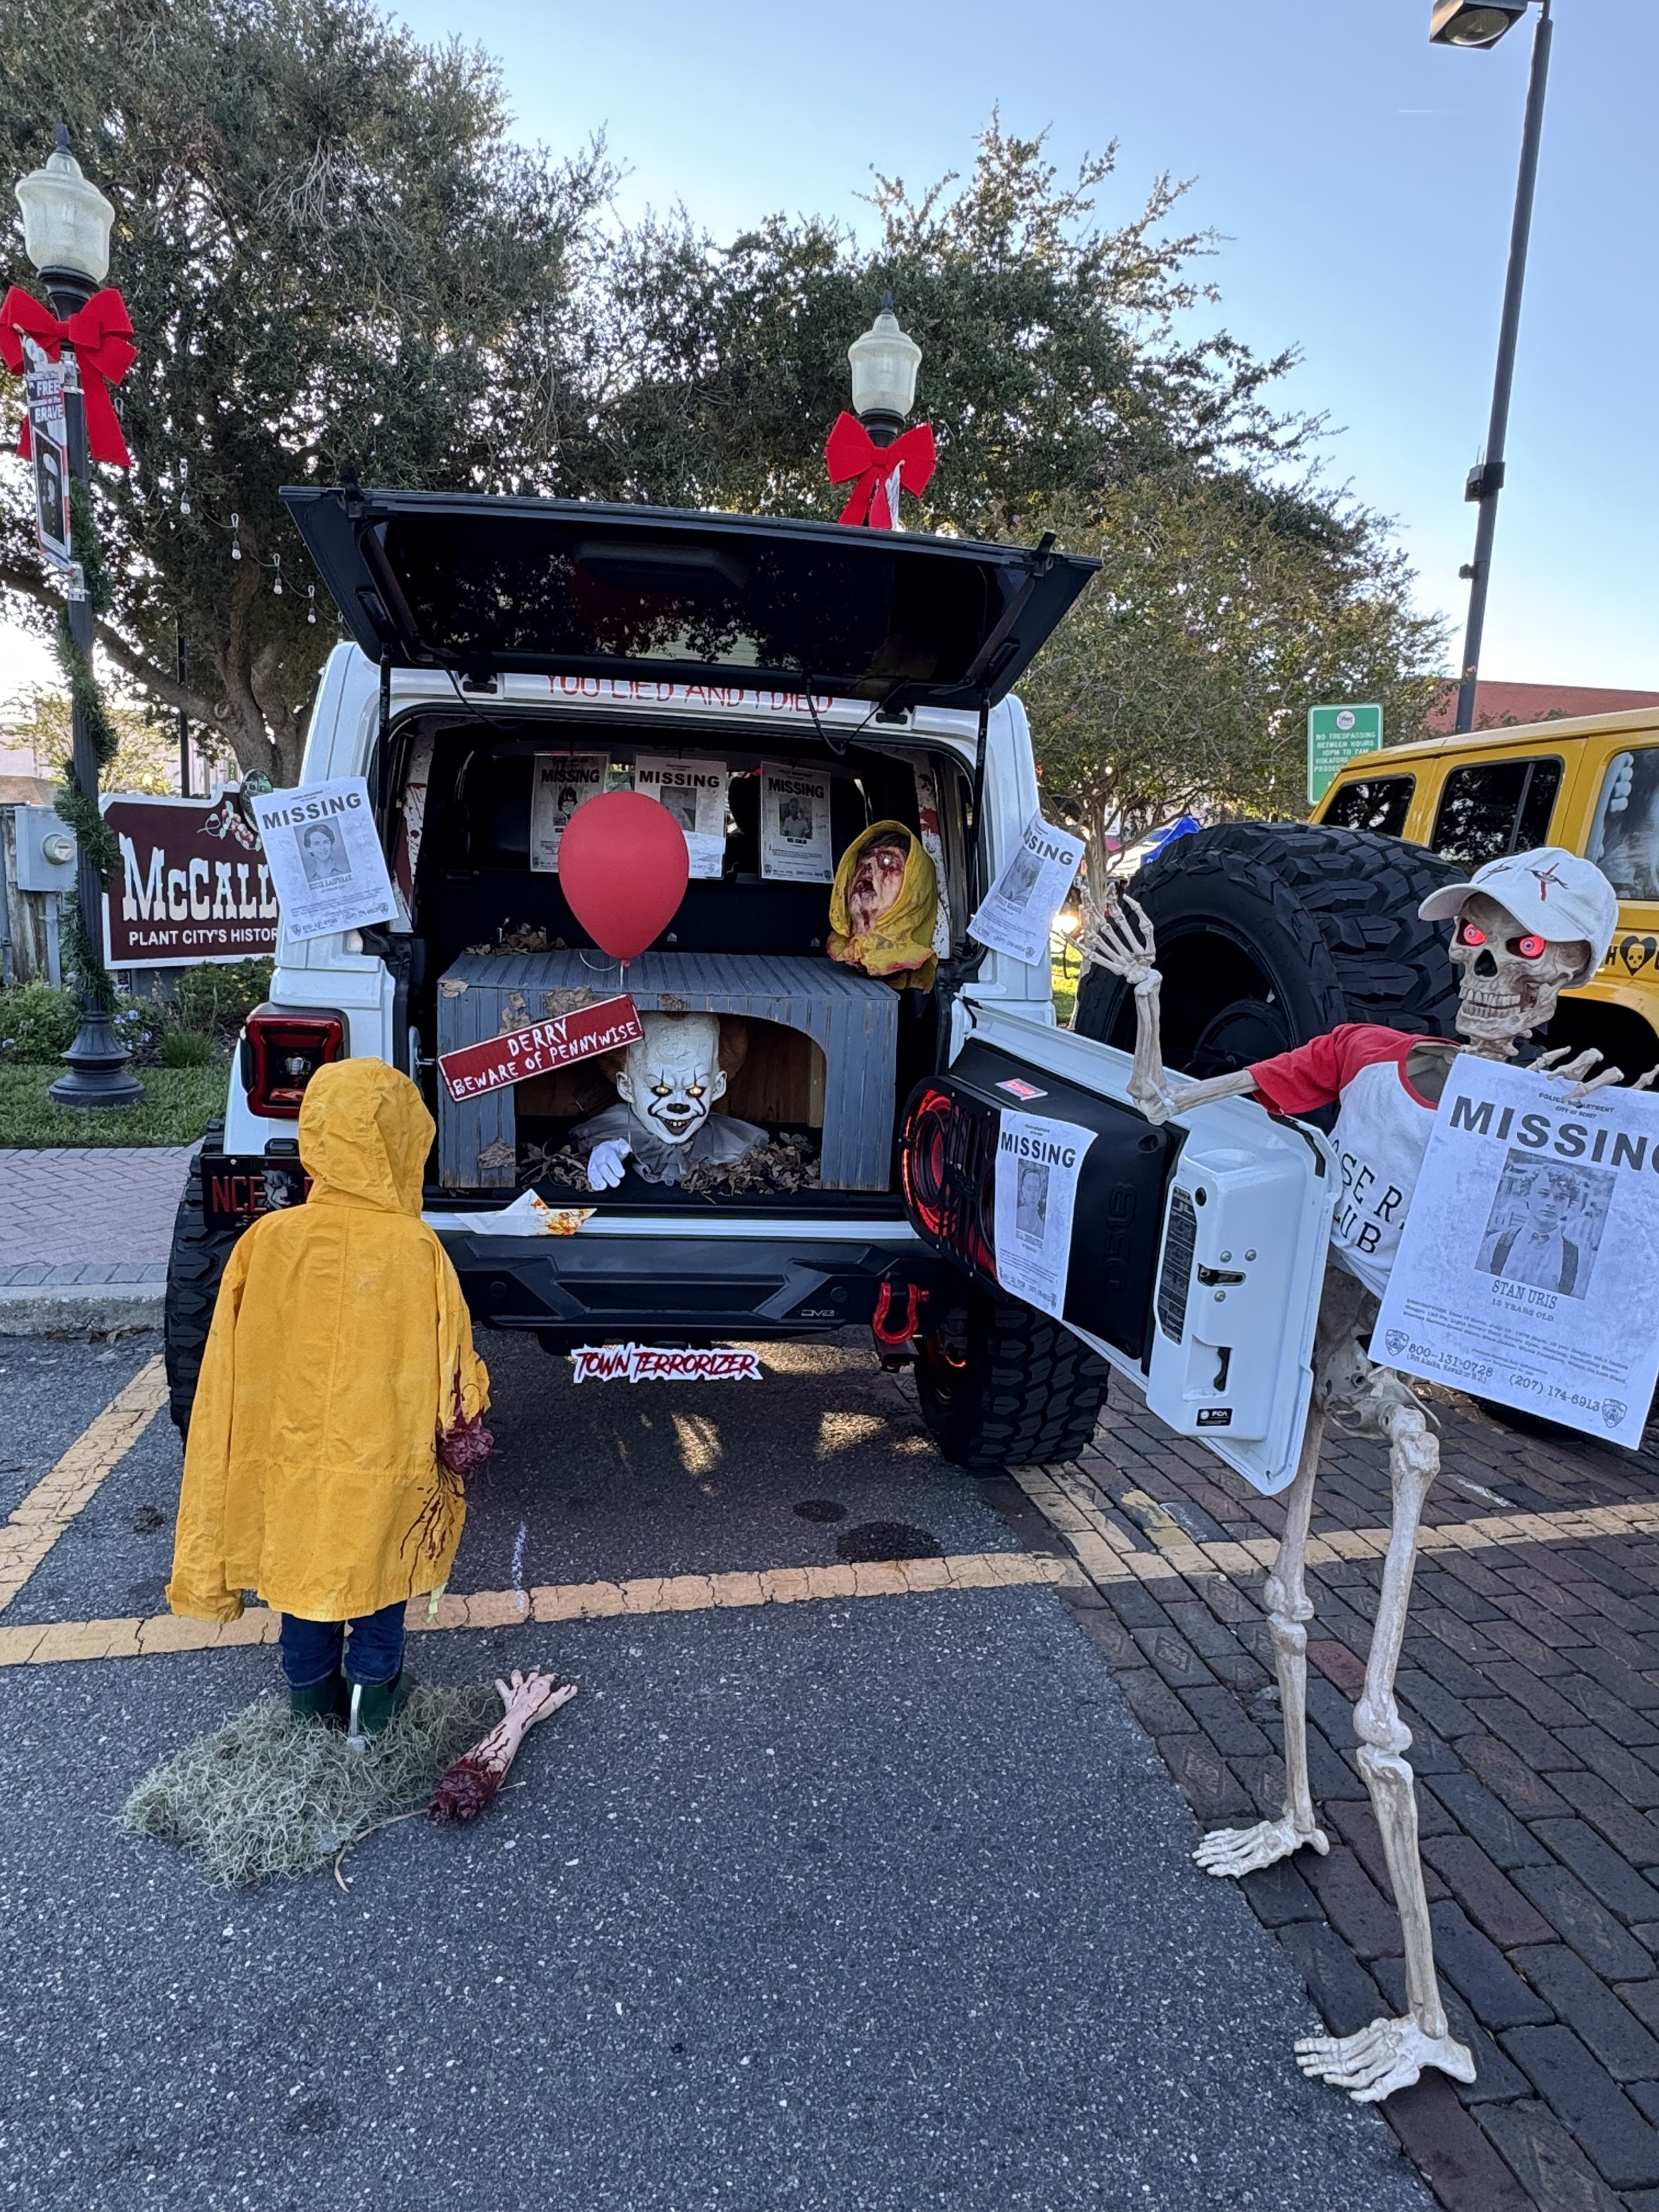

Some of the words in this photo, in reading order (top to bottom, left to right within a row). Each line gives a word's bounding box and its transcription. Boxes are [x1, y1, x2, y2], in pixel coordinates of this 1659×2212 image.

[36, 380, 60, 396] FREE
[35, 404, 64, 423] BRAVE
[547, 675, 599, 697] YOU
[610, 680, 674, 703] LIED
[684, 684, 745, 708] AND
[770, 692, 834, 714] DIED
[1329, 731, 1376, 740] TRESPASSING
[541, 769, 601, 784] MISSING
[639, 770, 720, 788] MISSING
[768, 776, 825, 798] MISSING
[262, 792, 362, 830] MISSING
[129, 930, 179, 946] PLANT
[182, 928, 227, 945] CITY'S
[507, 1019, 567, 1057] DERRY
[452, 1062, 518, 1095] BEWARE
[524, 1051, 542, 1070] OF
[550, 1021, 637, 1065] PENNYWISE
[1001, 1132, 1076, 1168] MISSING
[1449, 1096, 1659, 1177] MISSIN
[1491, 1279, 1526, 1301] STAN
[1526, 1289, 1557, 1309] URIS
[1504, 1301, 1534, 1316] YEARS
[1535, 1311, 1554, 1322] OLD
[577, 1350, 631, 1376] TOWN
[633, 1351, 759, 1378] TERRORIZER
[1509, 1374, 1544, 1394] (207)
[1547, 1386, 1601, 1412] 174-6913
